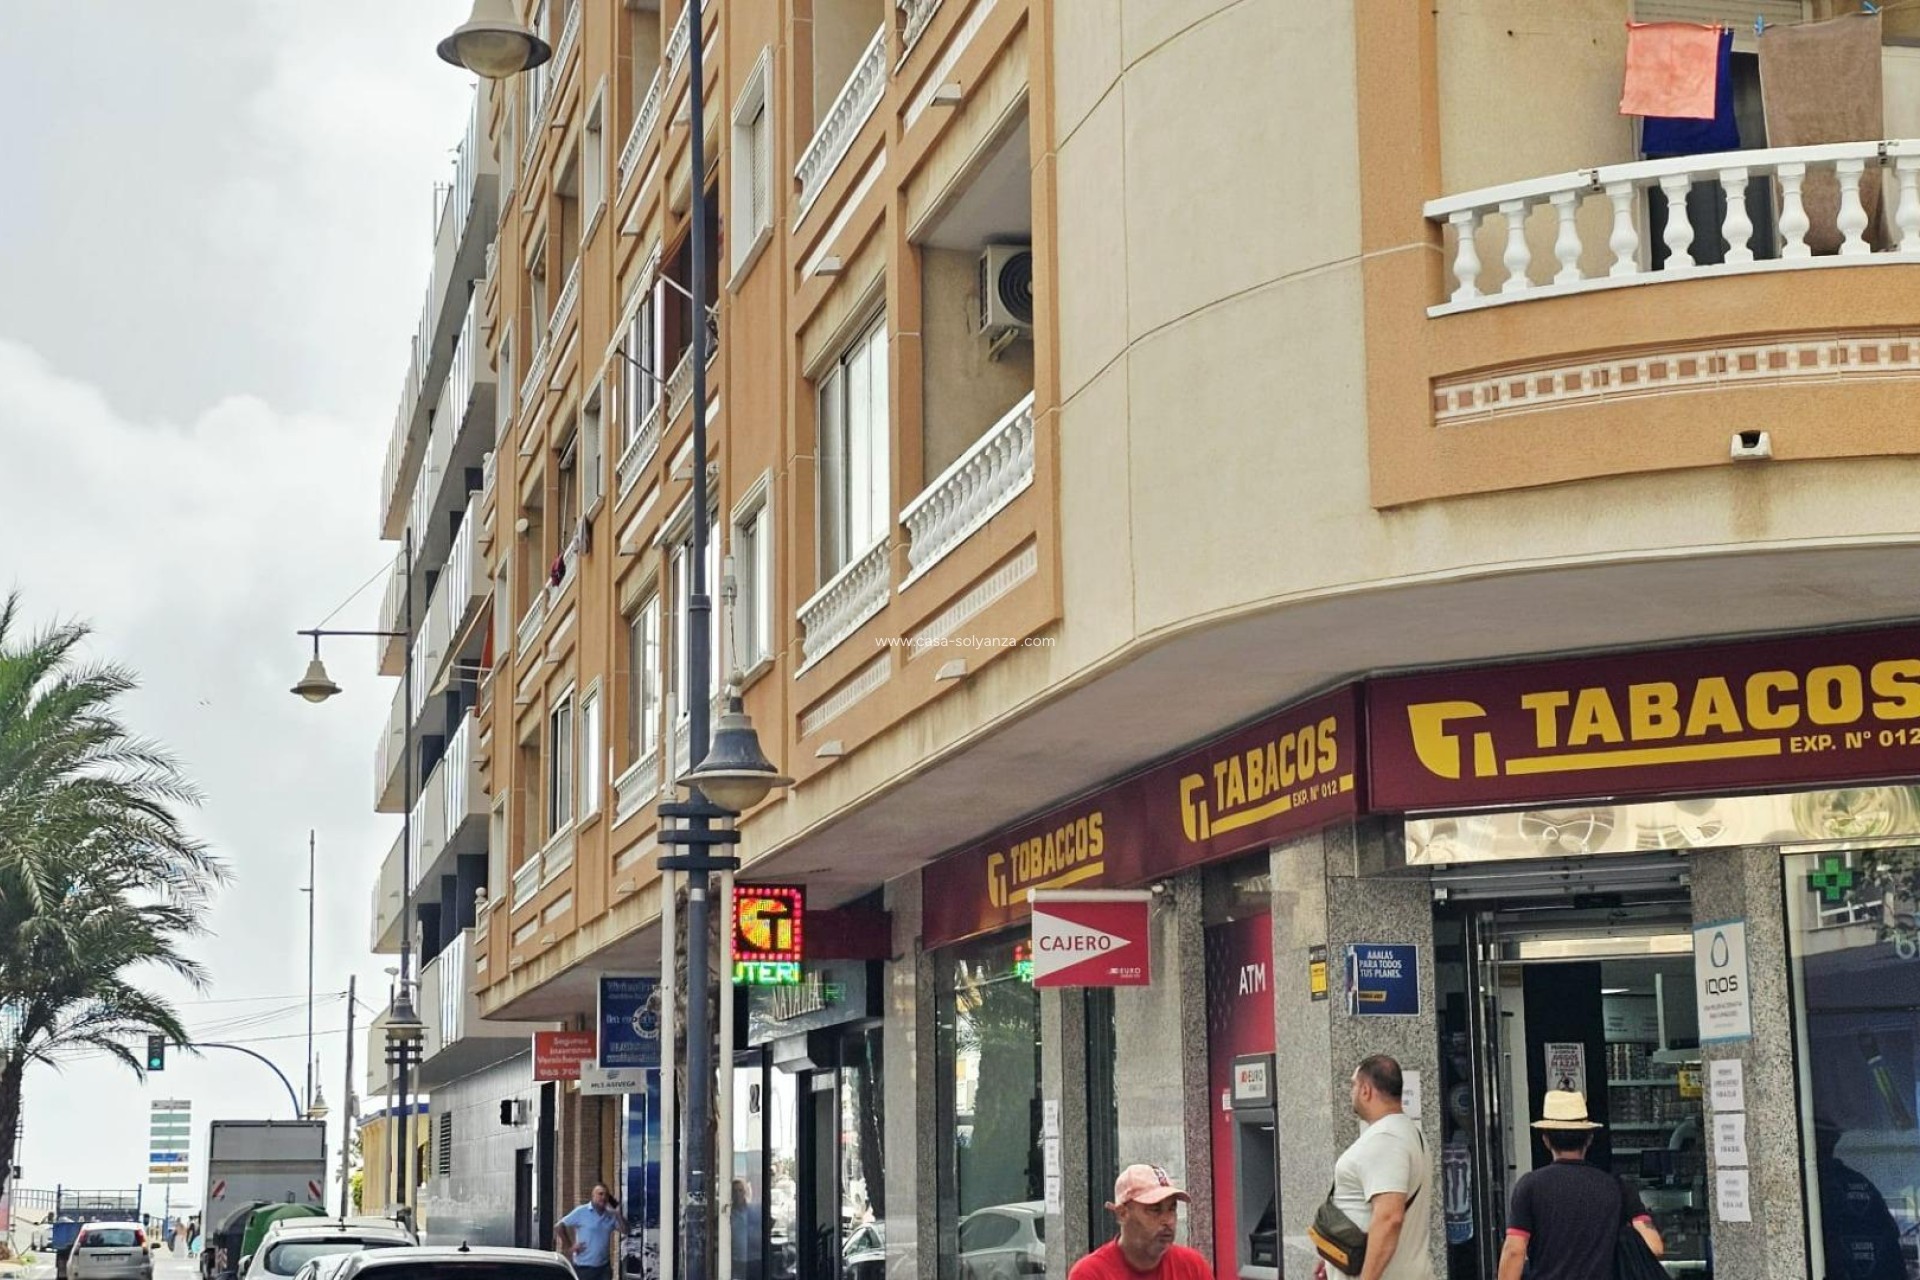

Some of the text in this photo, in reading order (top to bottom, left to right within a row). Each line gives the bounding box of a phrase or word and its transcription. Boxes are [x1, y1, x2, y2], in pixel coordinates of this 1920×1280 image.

[1521, 658, 1920, 749] TABACOS
[1790, 734, 1836, 753] EXP.
[1879, 728, 1920, 747] 012
[1213, 716, 1338, 812] TABACOS
[1292, 789, 1310, 808] EXP.
[1321, 779, 1338, 798] 012
[1010, 811, 1104, 886] TOBACCOS
[1040, 935, 1111, 951] CAJERO
[1239, 962, 1266, 995] ATM
[1360, 960, 1402, 969] PARA TODOS
[1361, 970, 1373, 978] TUS
